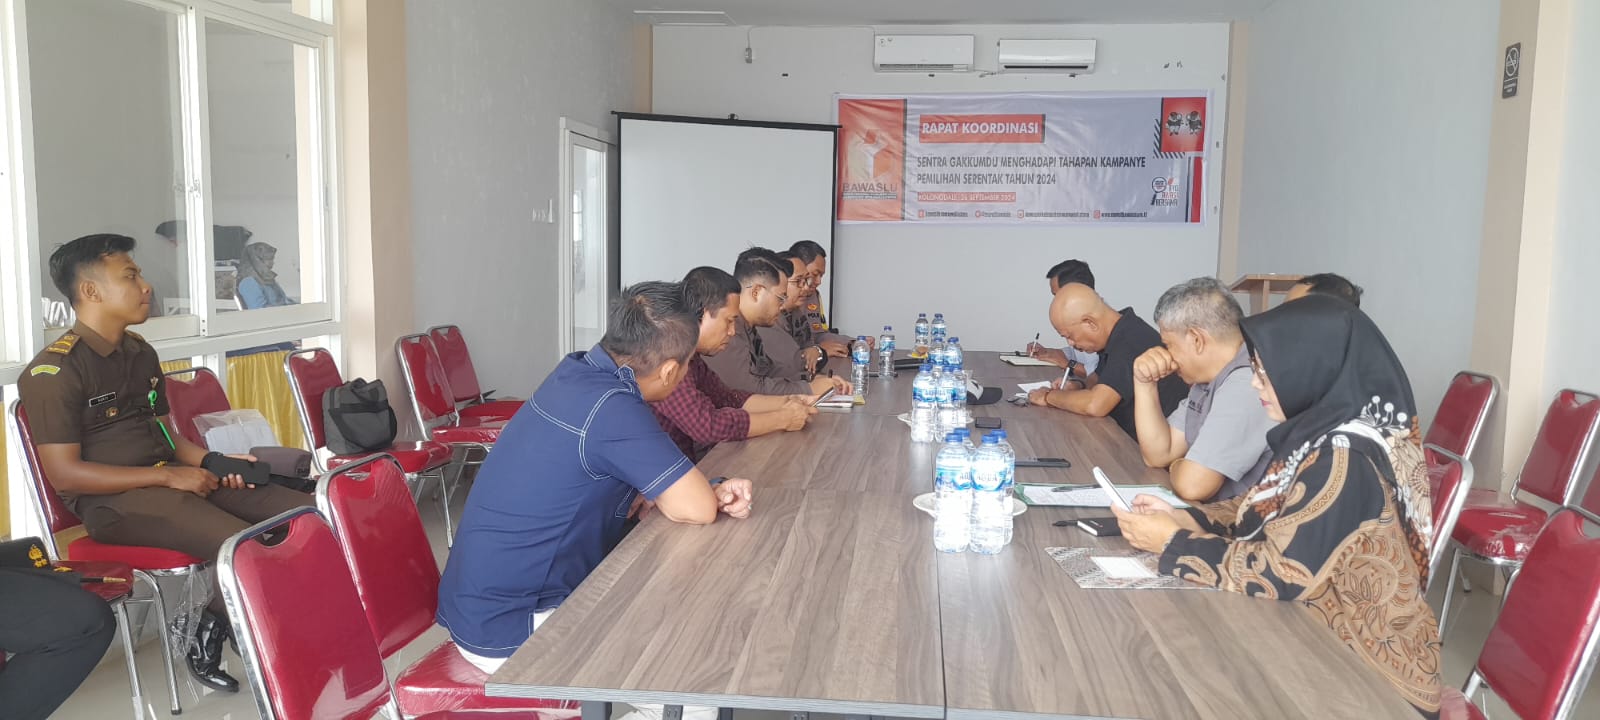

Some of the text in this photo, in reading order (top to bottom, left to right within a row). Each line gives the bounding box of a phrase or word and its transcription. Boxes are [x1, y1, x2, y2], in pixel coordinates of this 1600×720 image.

[922, 122, 1038, 134] RAPAT KOORDINASI
[917, 157, 1146, 167] SENTRA GAKKUMDU MENGHADAPI TAHAPAN KAMPANYE
[917, 174, 1056, 184] PEMILIHAN SERENTAK TAHUN 2024
[843, 183, 897, 192] BAWASLU
[978, 473, 998, 481] AQUA
